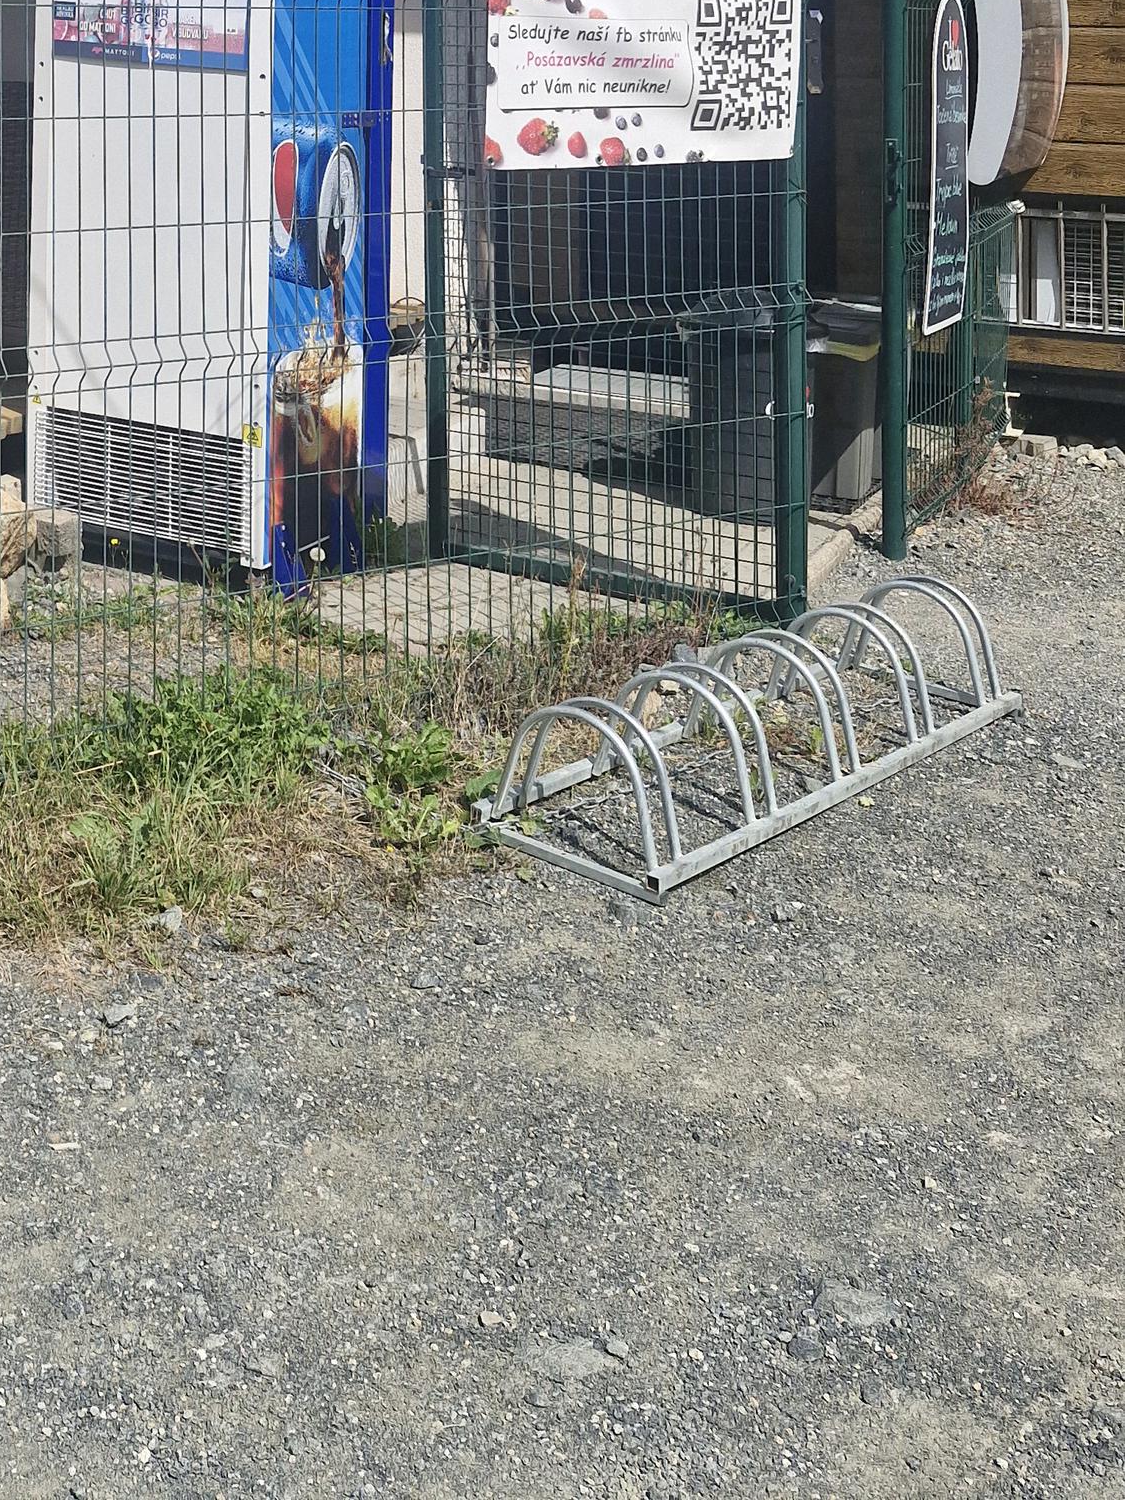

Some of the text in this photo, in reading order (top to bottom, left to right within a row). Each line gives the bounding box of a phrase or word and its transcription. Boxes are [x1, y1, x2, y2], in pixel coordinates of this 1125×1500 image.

[507, 23, 682, 44] Sledujte naší fb stránku
[521, 78, 672, 95] ať Vám nic neunikne!
